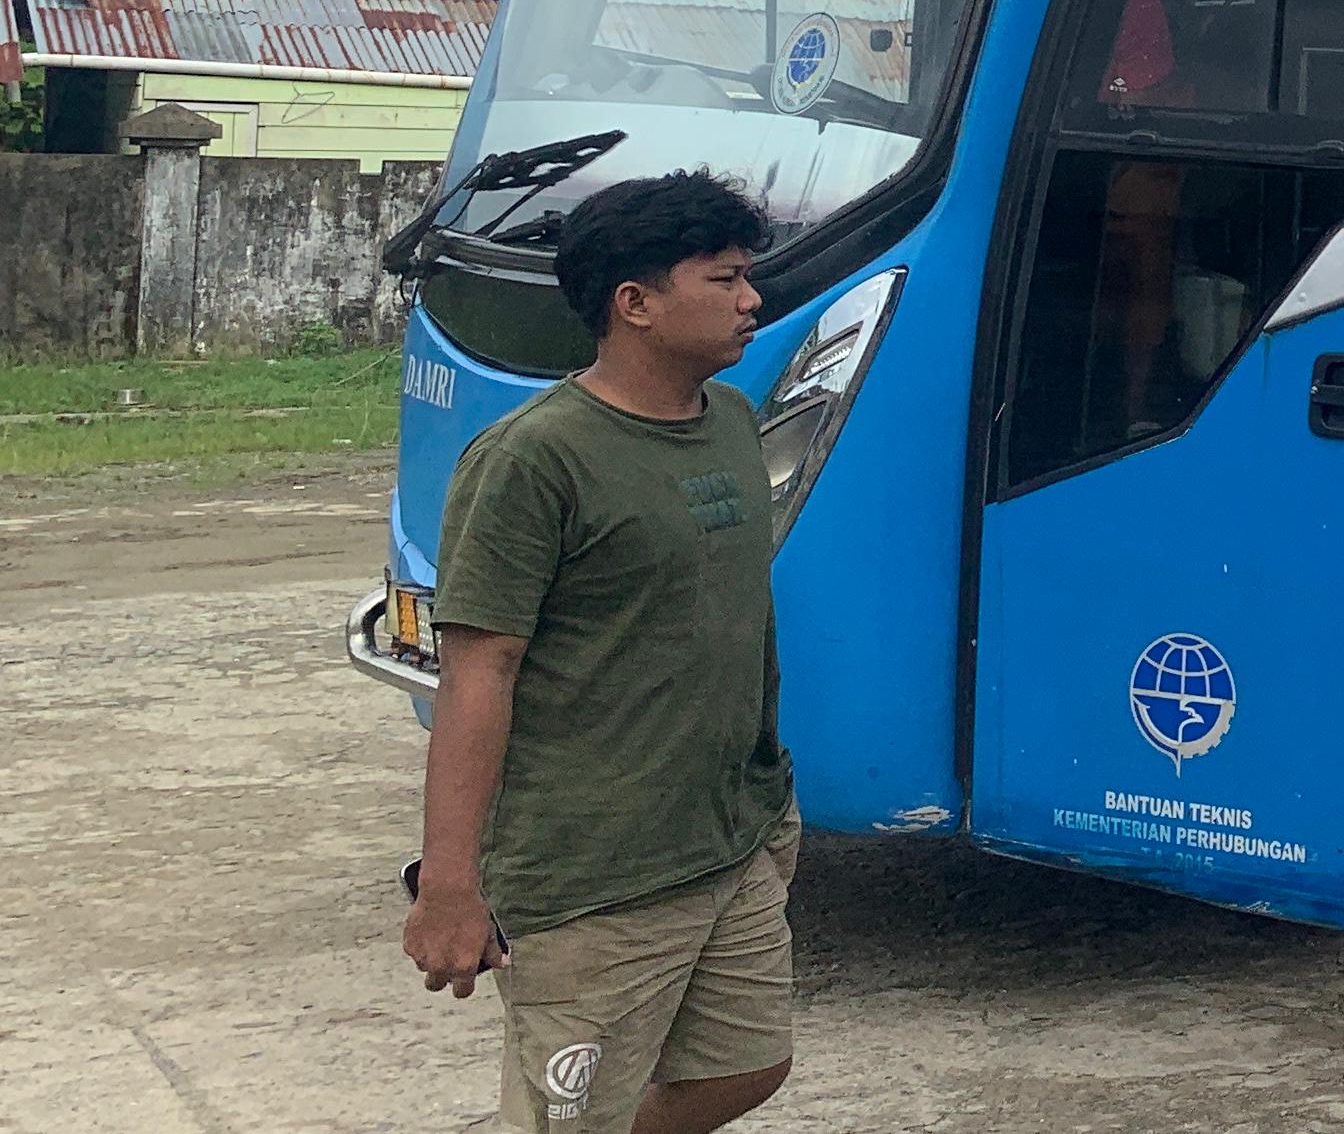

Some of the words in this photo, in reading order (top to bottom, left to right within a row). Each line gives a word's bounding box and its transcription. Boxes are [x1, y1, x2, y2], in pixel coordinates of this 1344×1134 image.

[404, 354, 456, 409] DAMRI
[1053, 809, 1171, 843] KEMENTERIAN
[1176, 827, 1306, 863] PERHUBUNGAN
[1104, 790, 1184, 819] BANTUAN
[1190, 803, 1252, 829] TEKNIS
